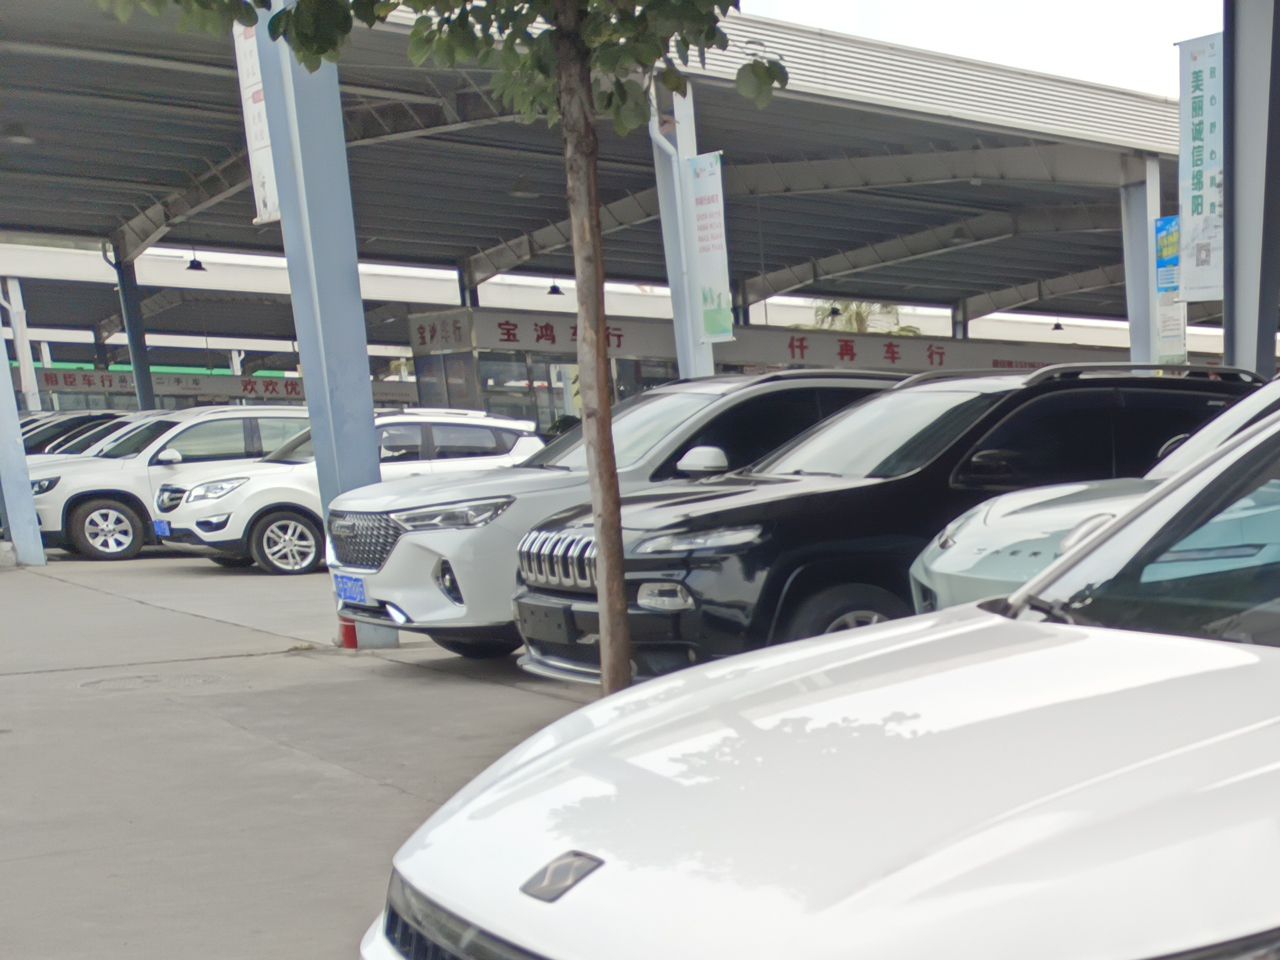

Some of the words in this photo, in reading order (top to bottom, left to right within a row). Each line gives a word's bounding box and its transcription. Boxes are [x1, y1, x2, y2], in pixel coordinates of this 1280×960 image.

[1191, 70, 1204, 217] 美丽诚信绵阳
